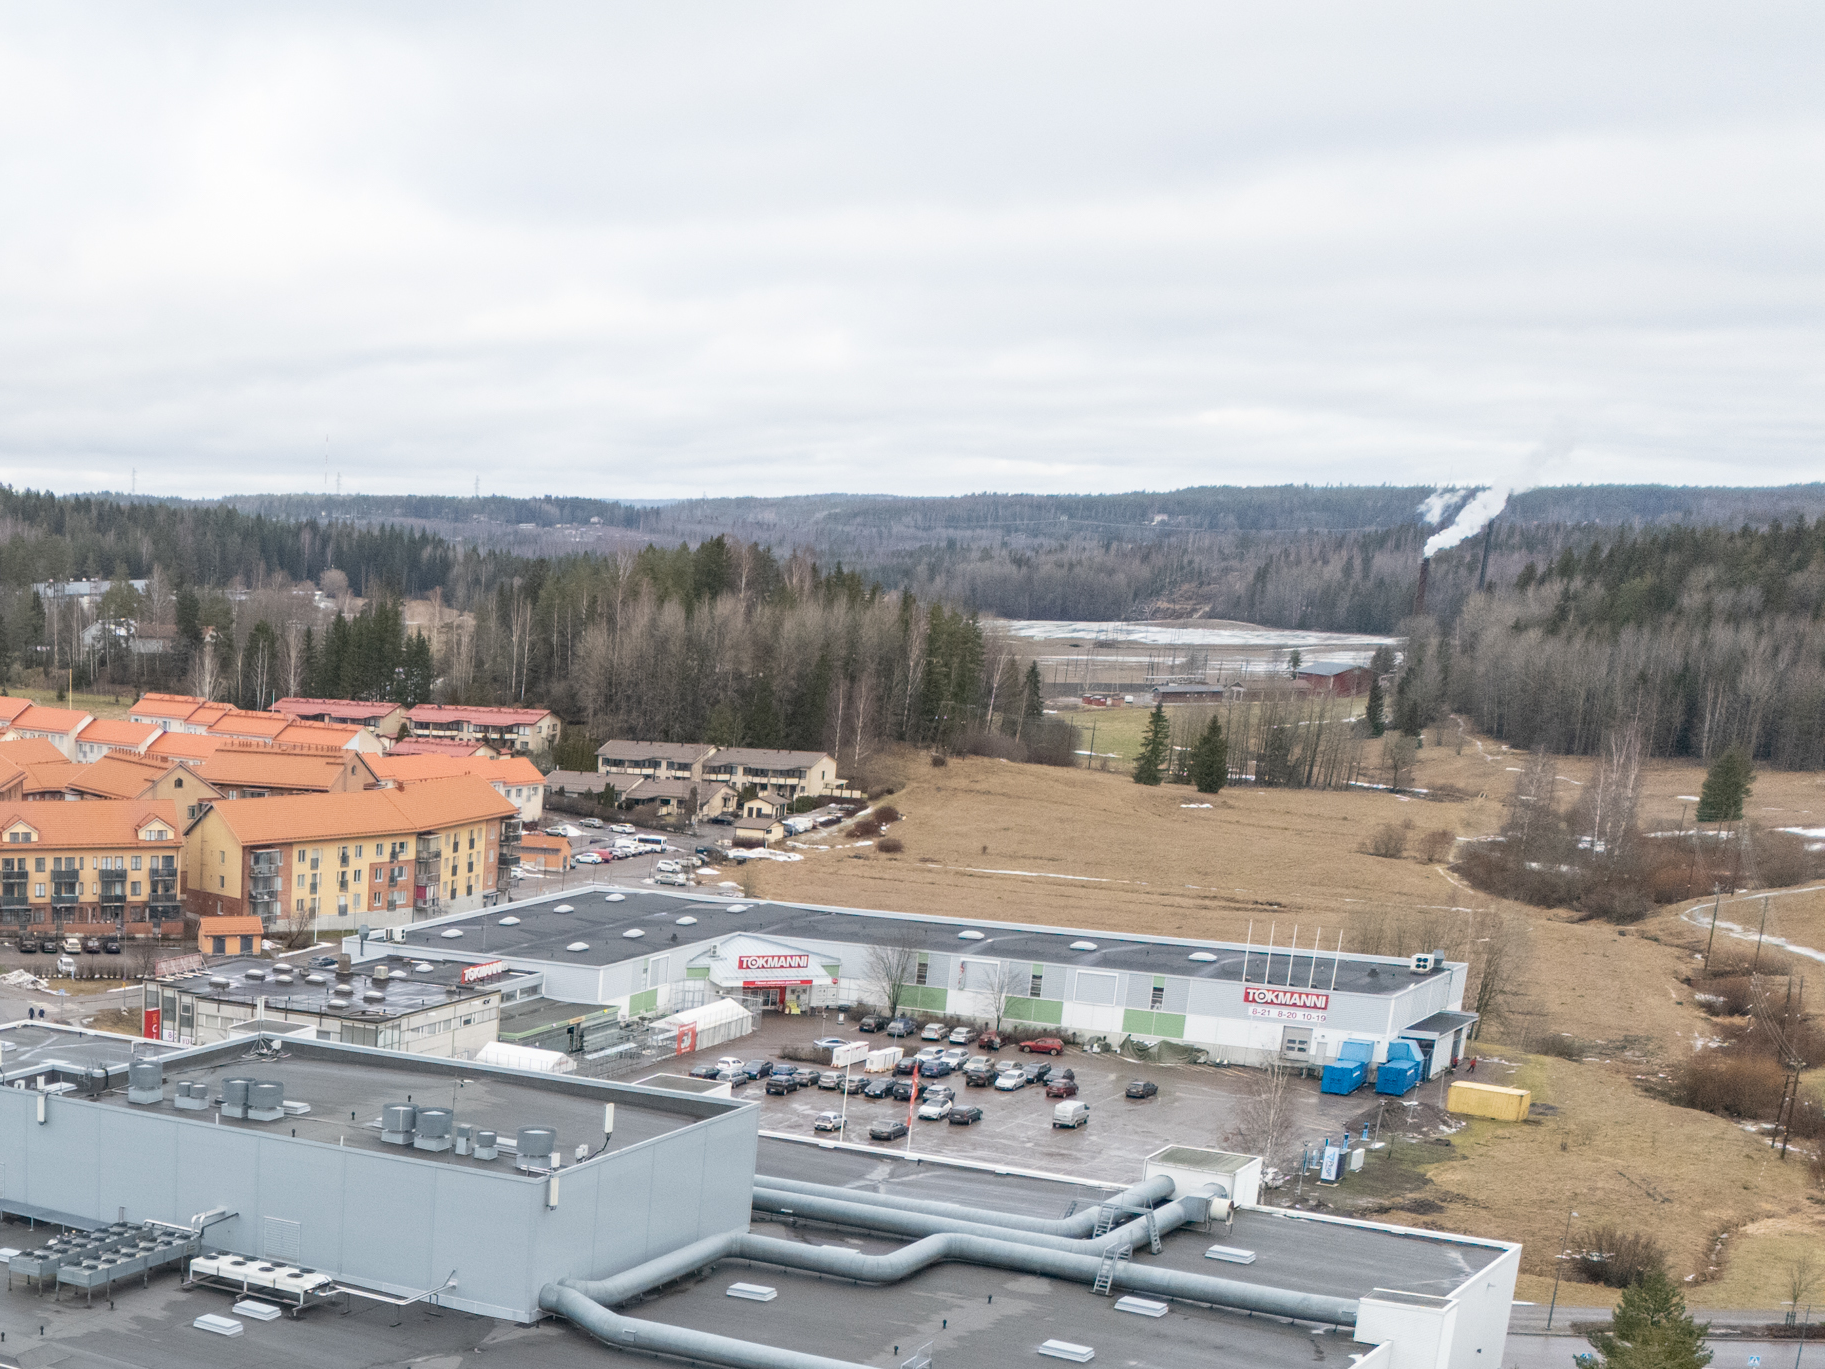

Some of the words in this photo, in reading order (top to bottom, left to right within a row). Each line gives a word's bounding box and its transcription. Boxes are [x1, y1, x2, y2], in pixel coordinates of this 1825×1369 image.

[741, 956, 807, 969] TOKMANNI
[1247, 989, 1326, 1008] TOKMANNI
[1252, 1008, 1271, 1016] 8-21
[1277, 1010, 1297, 1019] 8-20
[1302, 1013, 1326, 1022] 10-19
